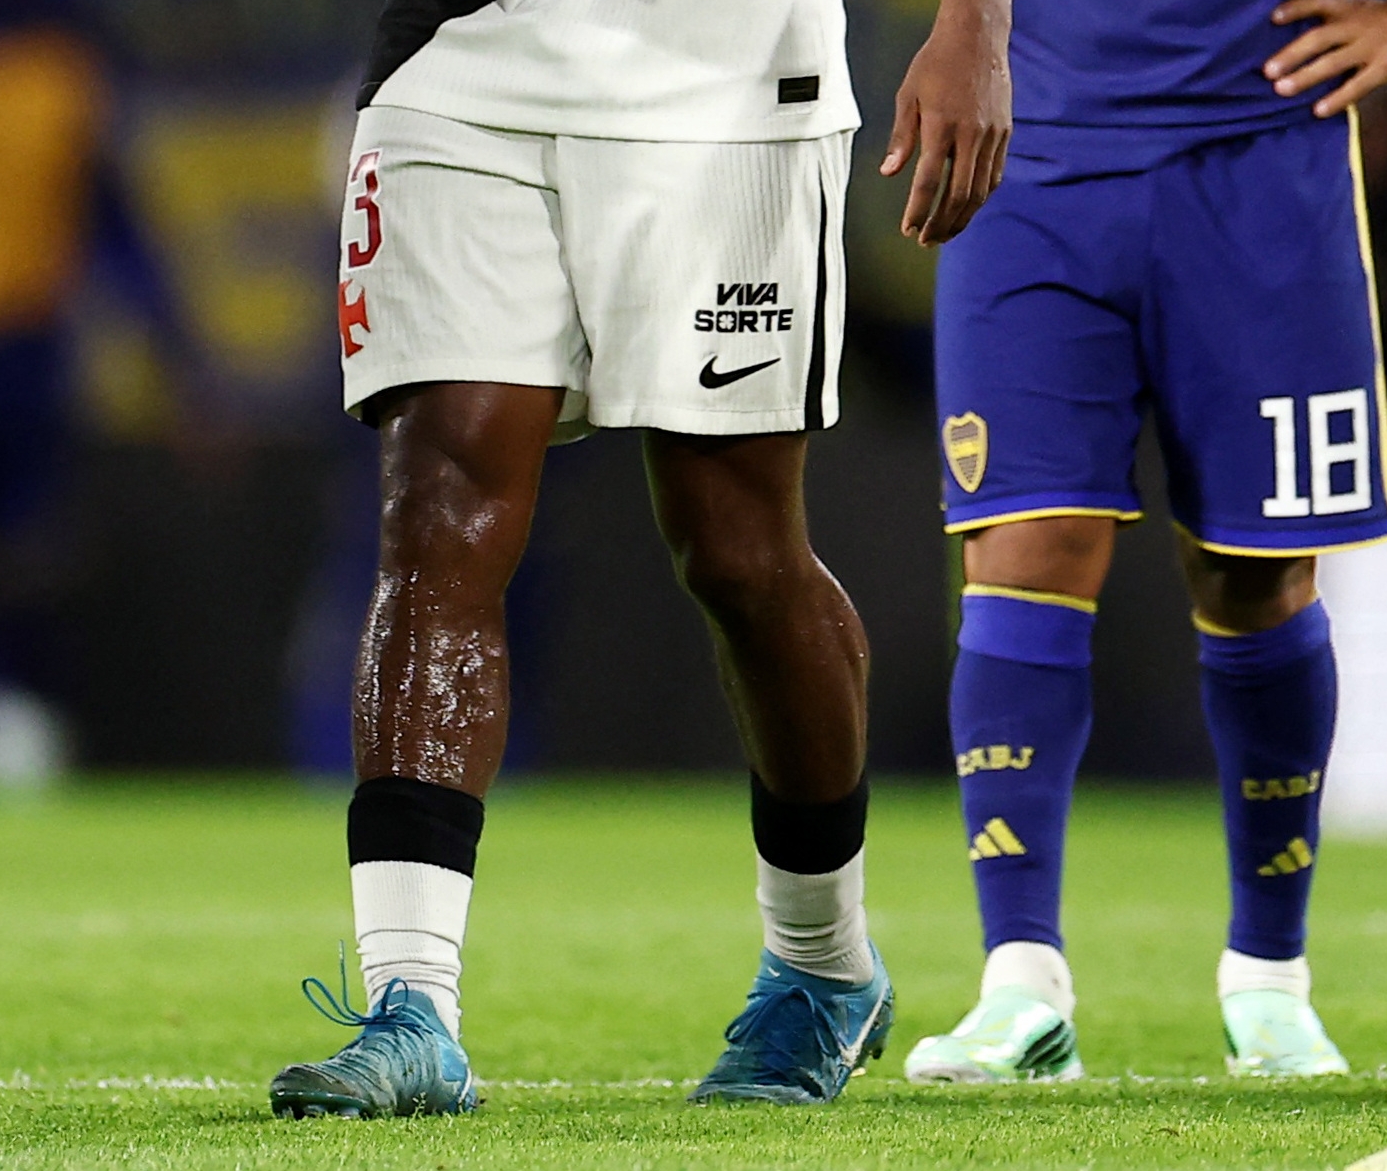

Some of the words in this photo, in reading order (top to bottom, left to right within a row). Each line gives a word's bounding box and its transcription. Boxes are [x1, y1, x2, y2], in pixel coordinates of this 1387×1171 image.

[717, 282, 778, 306] VIVA
[694, 308, 794, 333] SORTE
[1259, 388, 1371, 518] 18
